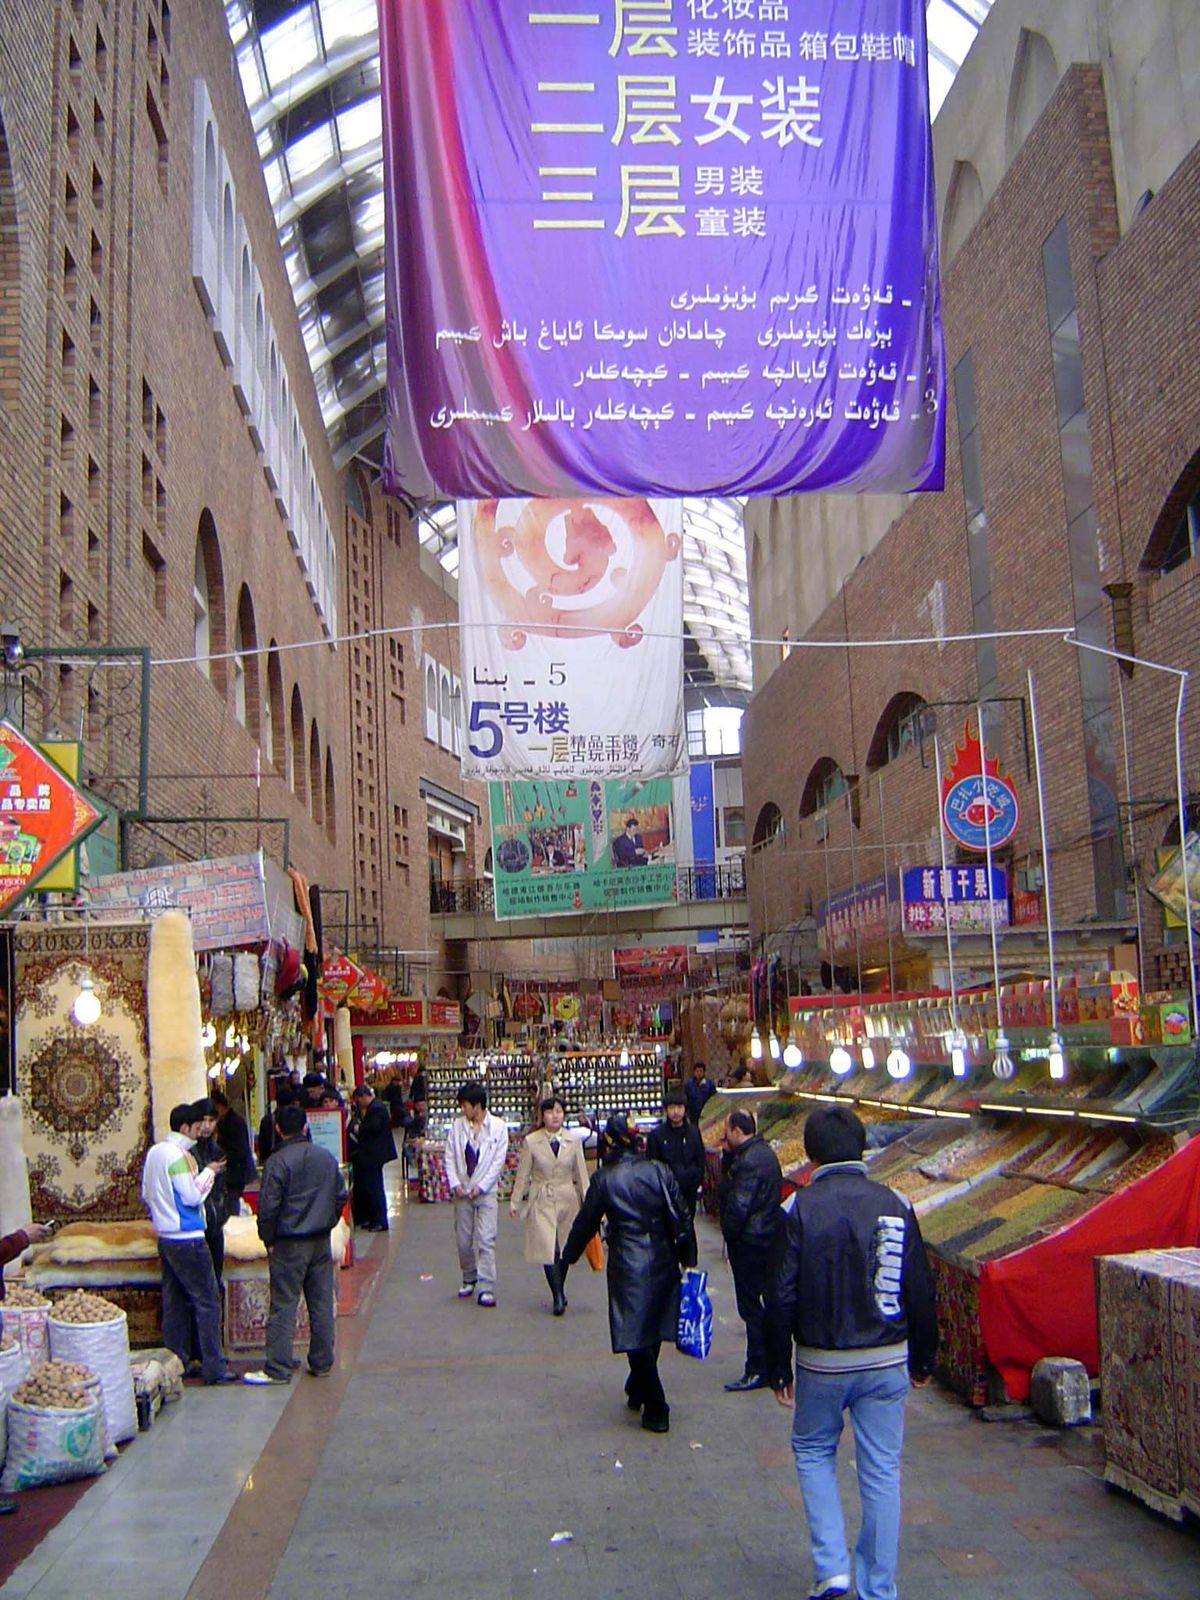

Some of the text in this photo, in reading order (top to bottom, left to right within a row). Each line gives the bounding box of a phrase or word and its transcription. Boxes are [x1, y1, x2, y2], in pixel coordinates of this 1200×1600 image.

[529, 0, 677, 57] 一层
[687, 28, 791, 58] 装饰品
[694, 166, 764, 196] 男装
[534, 165, 686, 238] 三层
[695, 207, 767, 238] 童装
[548, 662, 567, 686] 5
[528, 737, 569, 763] 一层
